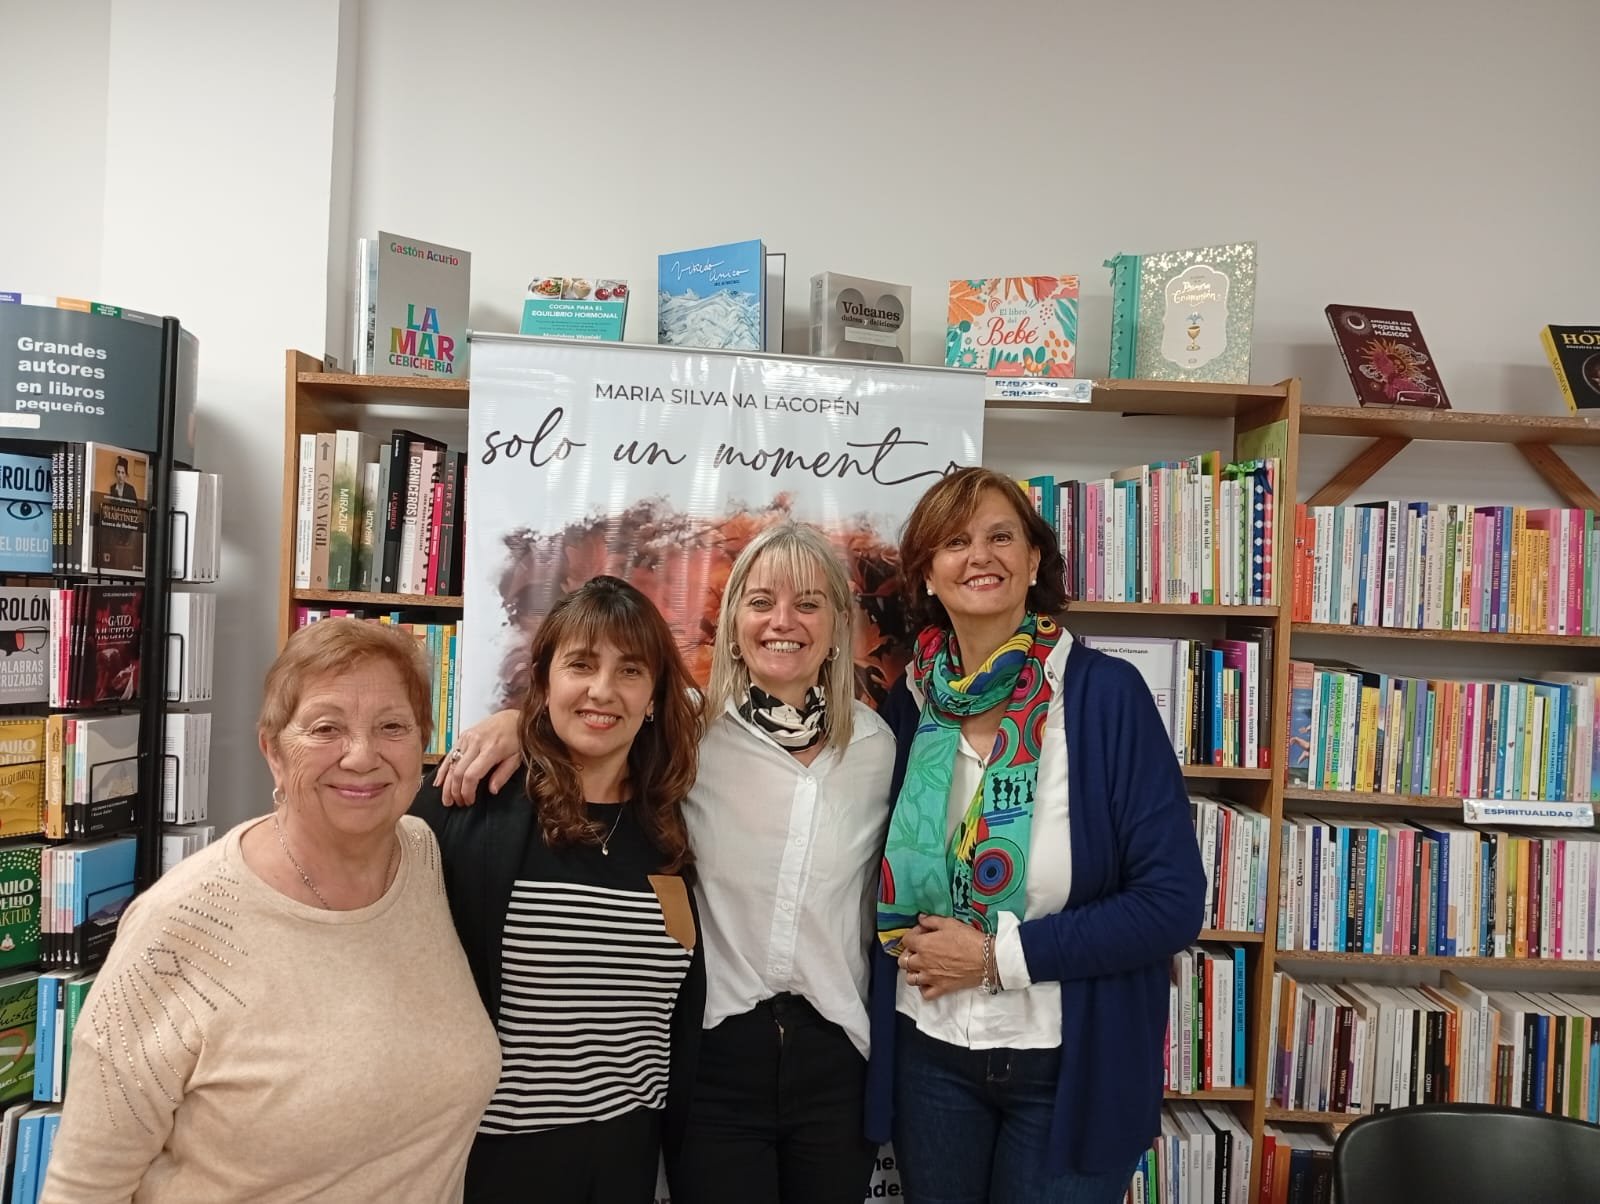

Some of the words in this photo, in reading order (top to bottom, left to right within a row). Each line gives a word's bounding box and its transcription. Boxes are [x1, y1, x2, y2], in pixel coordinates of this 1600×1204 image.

[390, 242, 424, 259] Gastón
[426, 250, 458, 266] Acurio
[406, 304, 440, 334] LA
[532, 310, 573, 318] EQUILIBRIO
[842, 301, 900, 321] Volcanes
[1000, 308, 1006, 316] El
[1008, 308, 1027, 316] libro
[976, 316, 1040, 346] Bebé
[1372, 324, 1412, 333] PODERES
[1374, 328, 1410, 338] MÁGICOS
[17, 336, 107, 360] Grandes
[390, 328, 455, 362] MAR
[18, 358, 105, 380] autores
[388, 354, 453, 374] CEBICHERÍA
[16, 382, 42, 394] en
[48, 381, 105, 400] libros
[595, 382, 665, 402] MARIA
[670, 388, 758, 410] SILVANA
[763, 394, 860, 417] LACOPÉN
[16, 400, 105, 416] pequeños
[481, 406, 586, 468] solo
[612, 438, 687, 465] un
[713, 426, 966, 486] momento
[317, 473, 328, 510] CASA
[406, 456, 421, 516] CARNICEROS
[445, 461, 454, 517] TIERRAS
[338, 488, 349, 532] MIRAZUR
[315, 513, 328, 550] VIGIL
[365, 510, 374, 545] MIRAZUR
[405, 517, 416, 529] DE
[1, 536, 12, 551] EL
[16, 536, 49, 553] DUELO
[0, 594, 50, 622] ROLÓN
[108, 615, 132, 626] GATO
[0, 660, 44, 674] ALABRAS
[0, 672, 44, 686] RUZADAS
[0, 738, 36, 754] AULO
[1484, 808, 1572, 818] ESPIRITUALIDAD
[1358, 835, 1367, 875] RUGE
[0, 878, 34, 896] AULO
[0, 894, 34, 910] ELHO
[0, 908, 32, 926] KTUB
